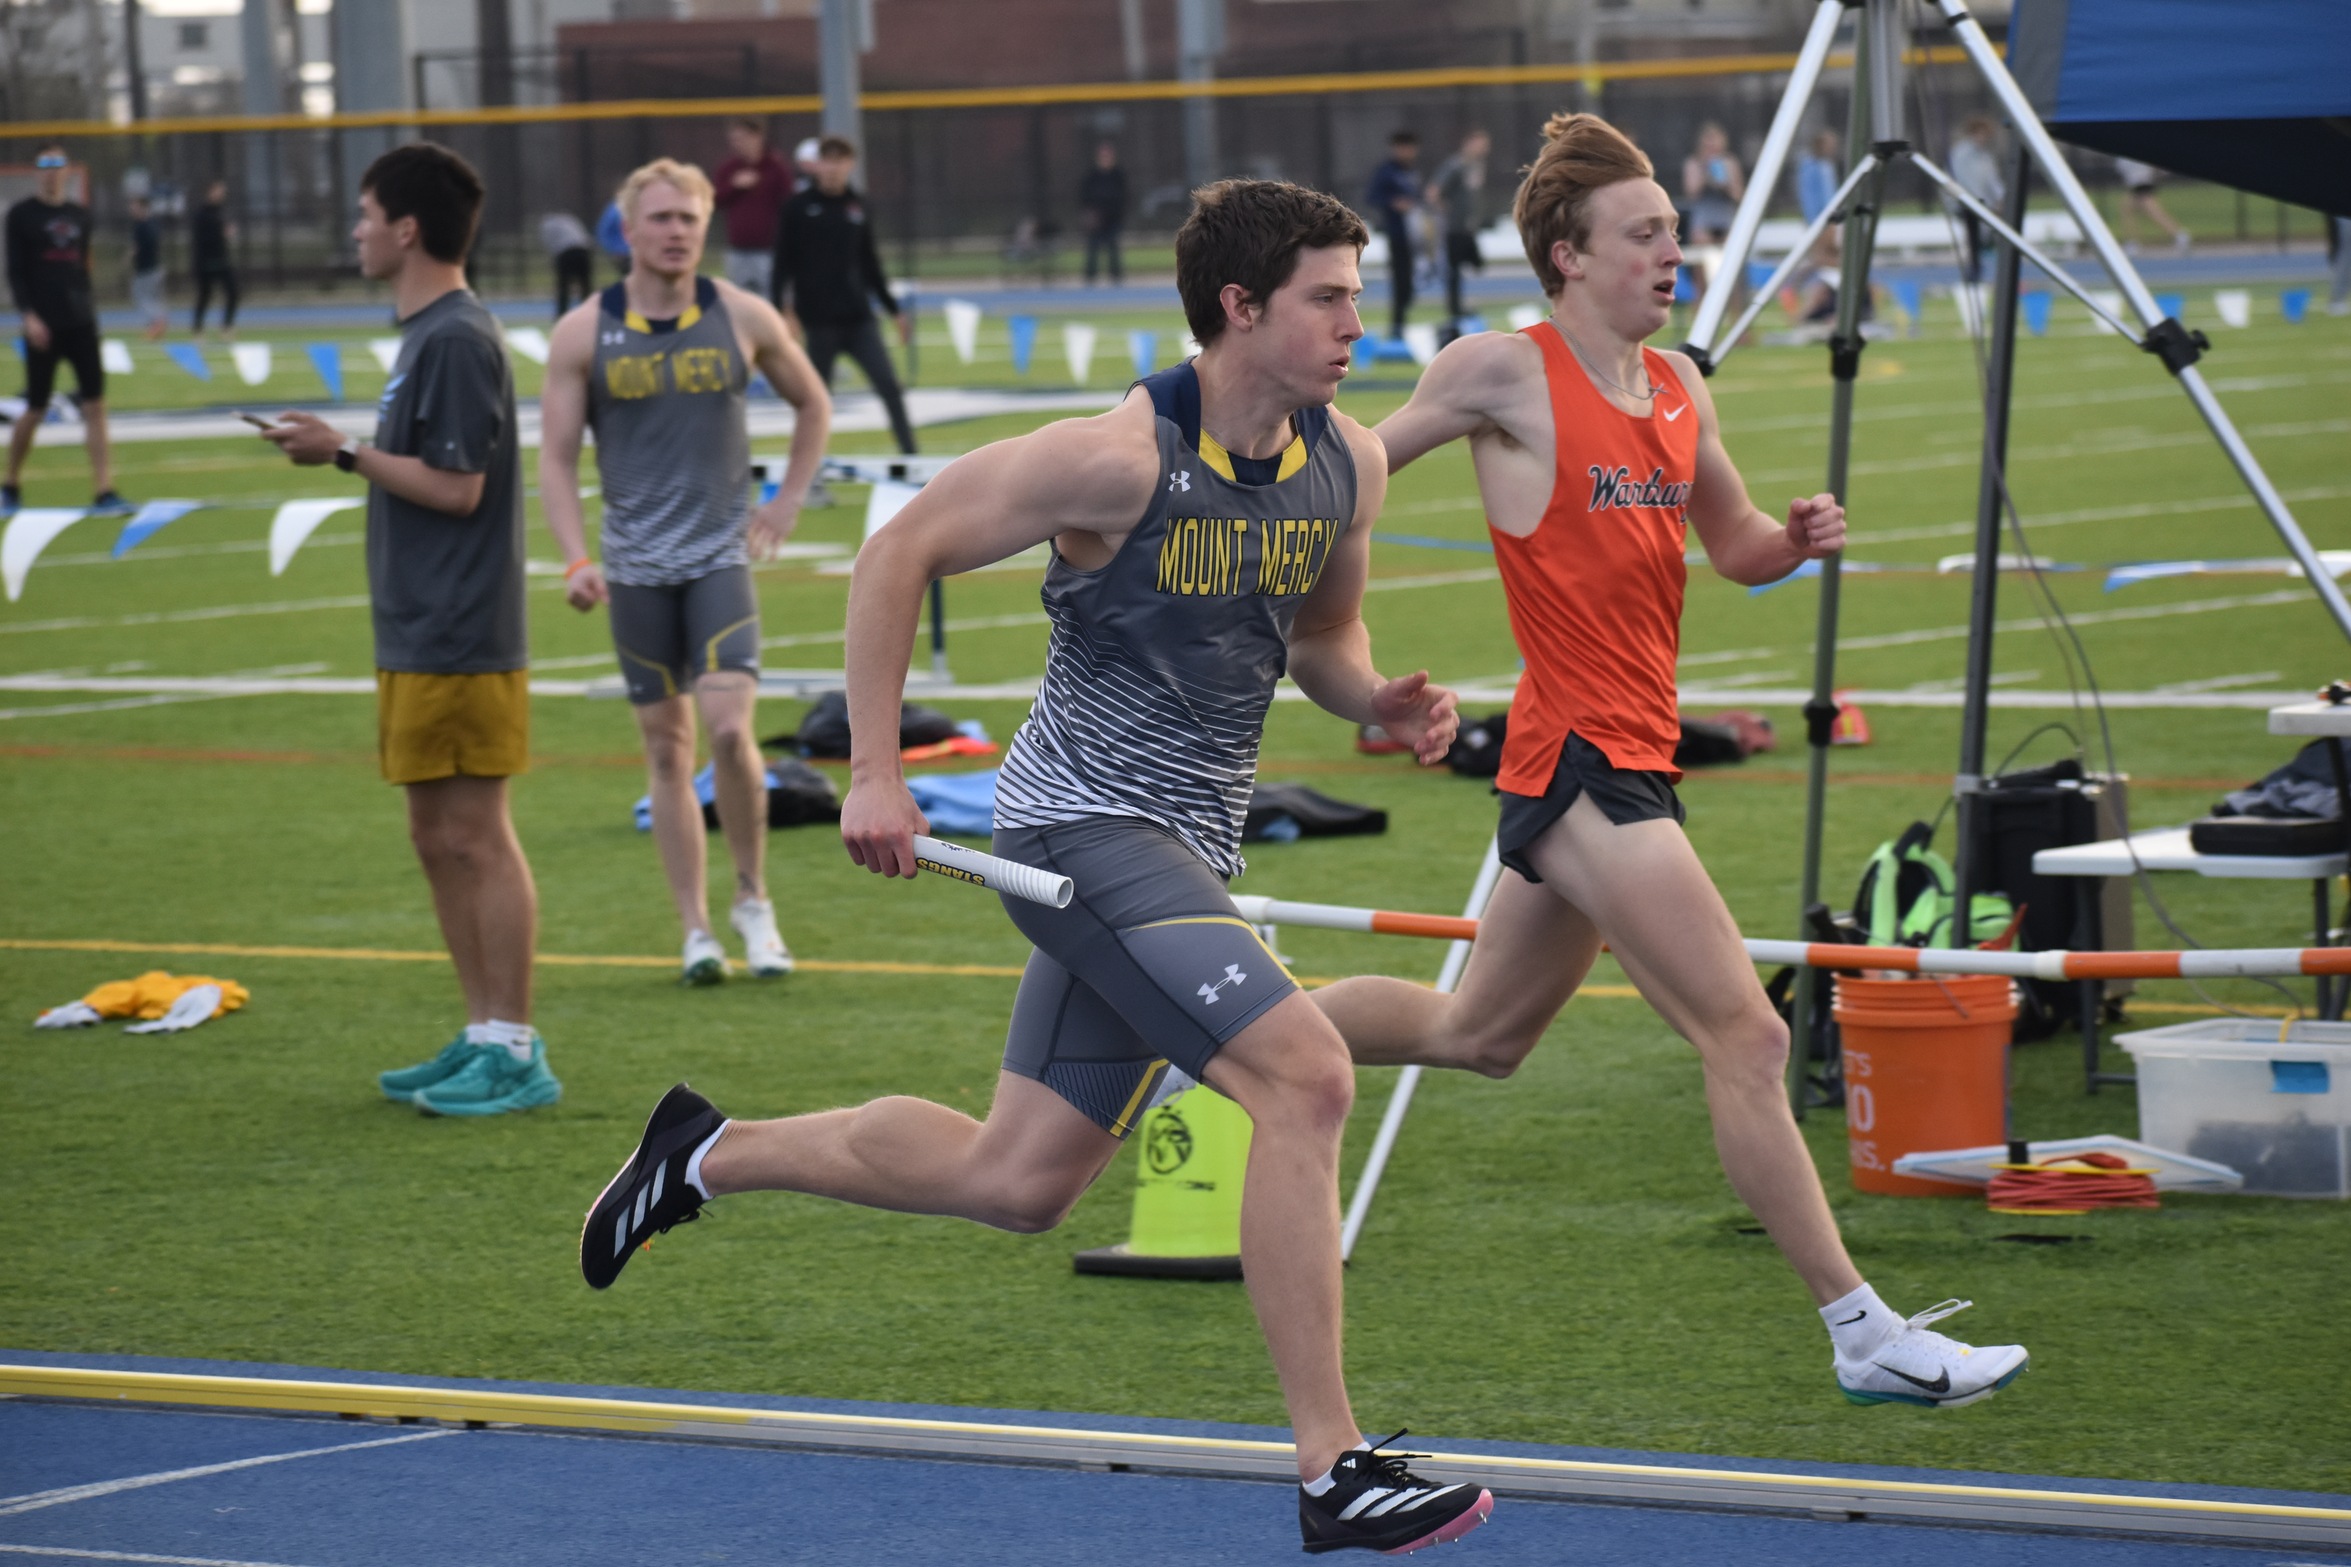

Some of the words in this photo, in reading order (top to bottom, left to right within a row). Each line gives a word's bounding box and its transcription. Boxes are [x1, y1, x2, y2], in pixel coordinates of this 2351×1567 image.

[672, 348, 733, 393] MERCY
[1156, 517, 1248, 595] MOUNT
[1254, 518, 1339, 596] MERCY
[916, 857, 985, 886] STANGS
